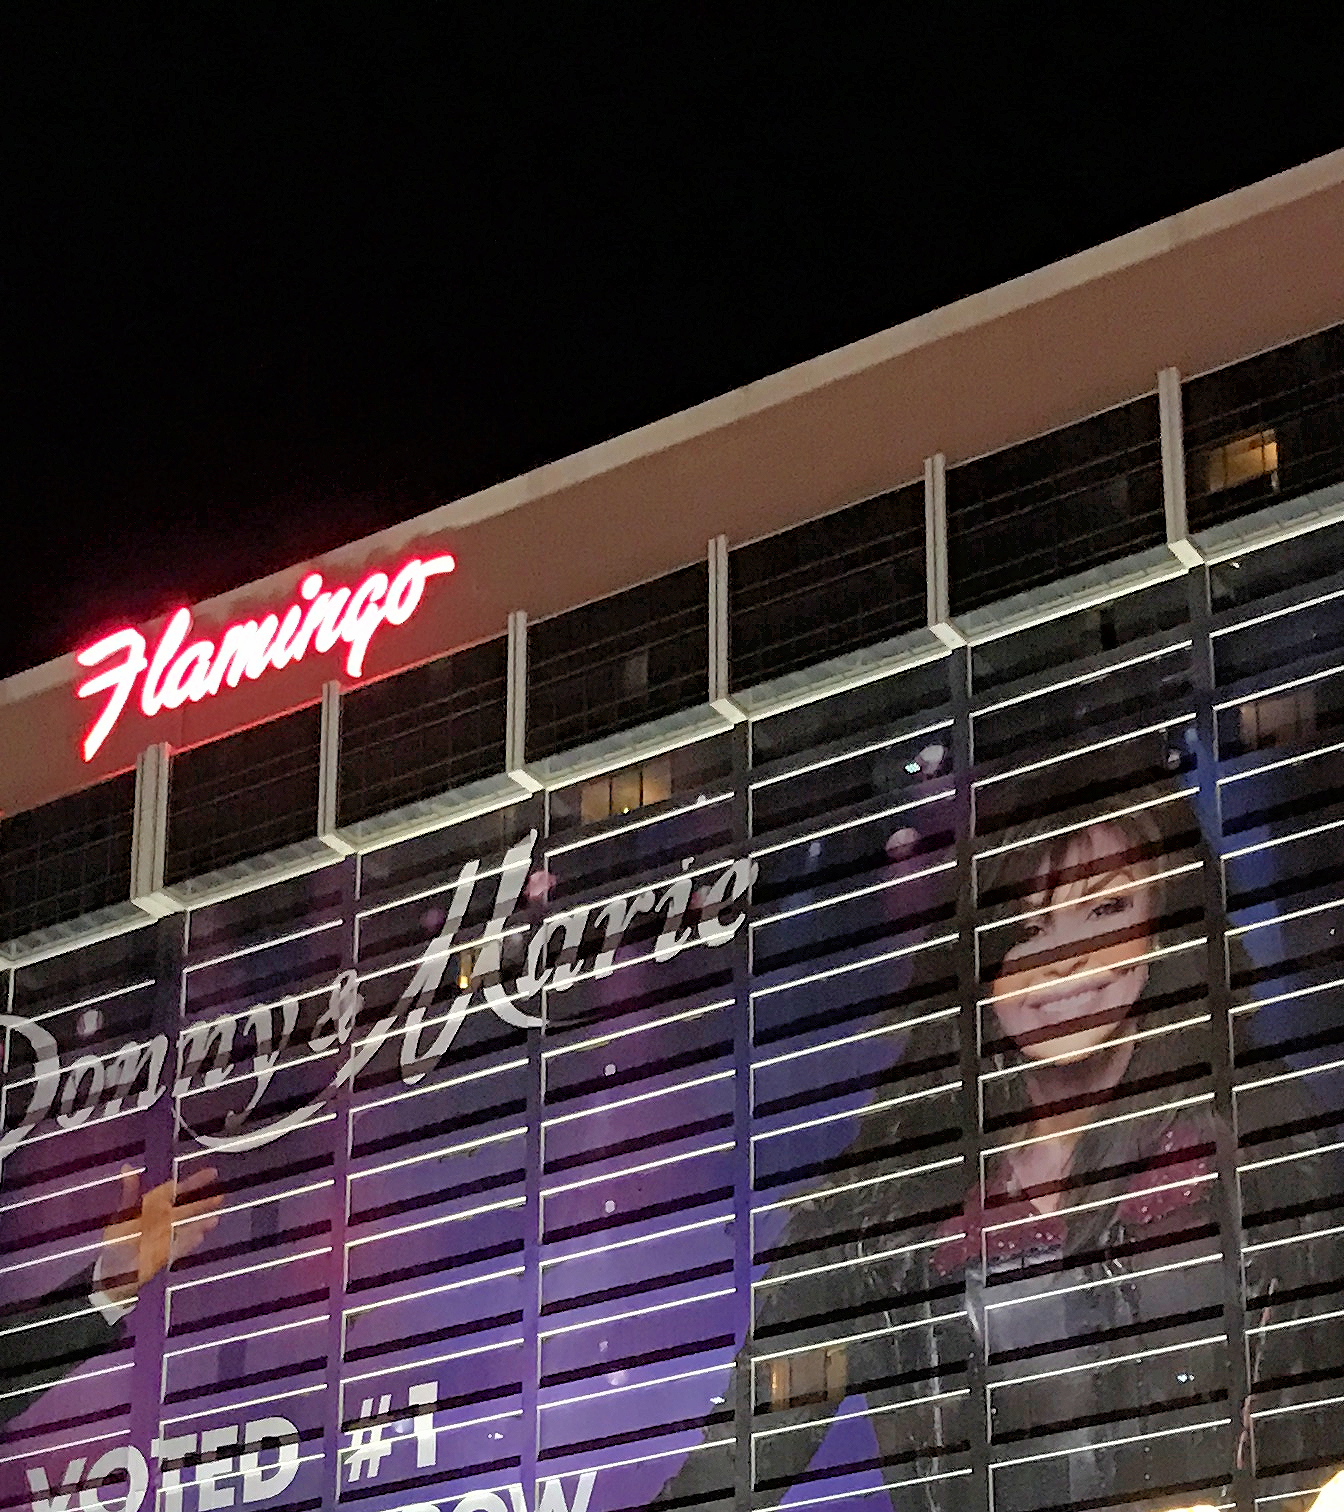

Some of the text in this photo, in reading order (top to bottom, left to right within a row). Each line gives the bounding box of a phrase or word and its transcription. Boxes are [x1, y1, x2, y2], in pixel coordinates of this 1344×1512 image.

[76, 551, 456, 763] Flamingo
[346, 828, 762, 1085] Marie
[345, 1380, 440, 1483] #1
